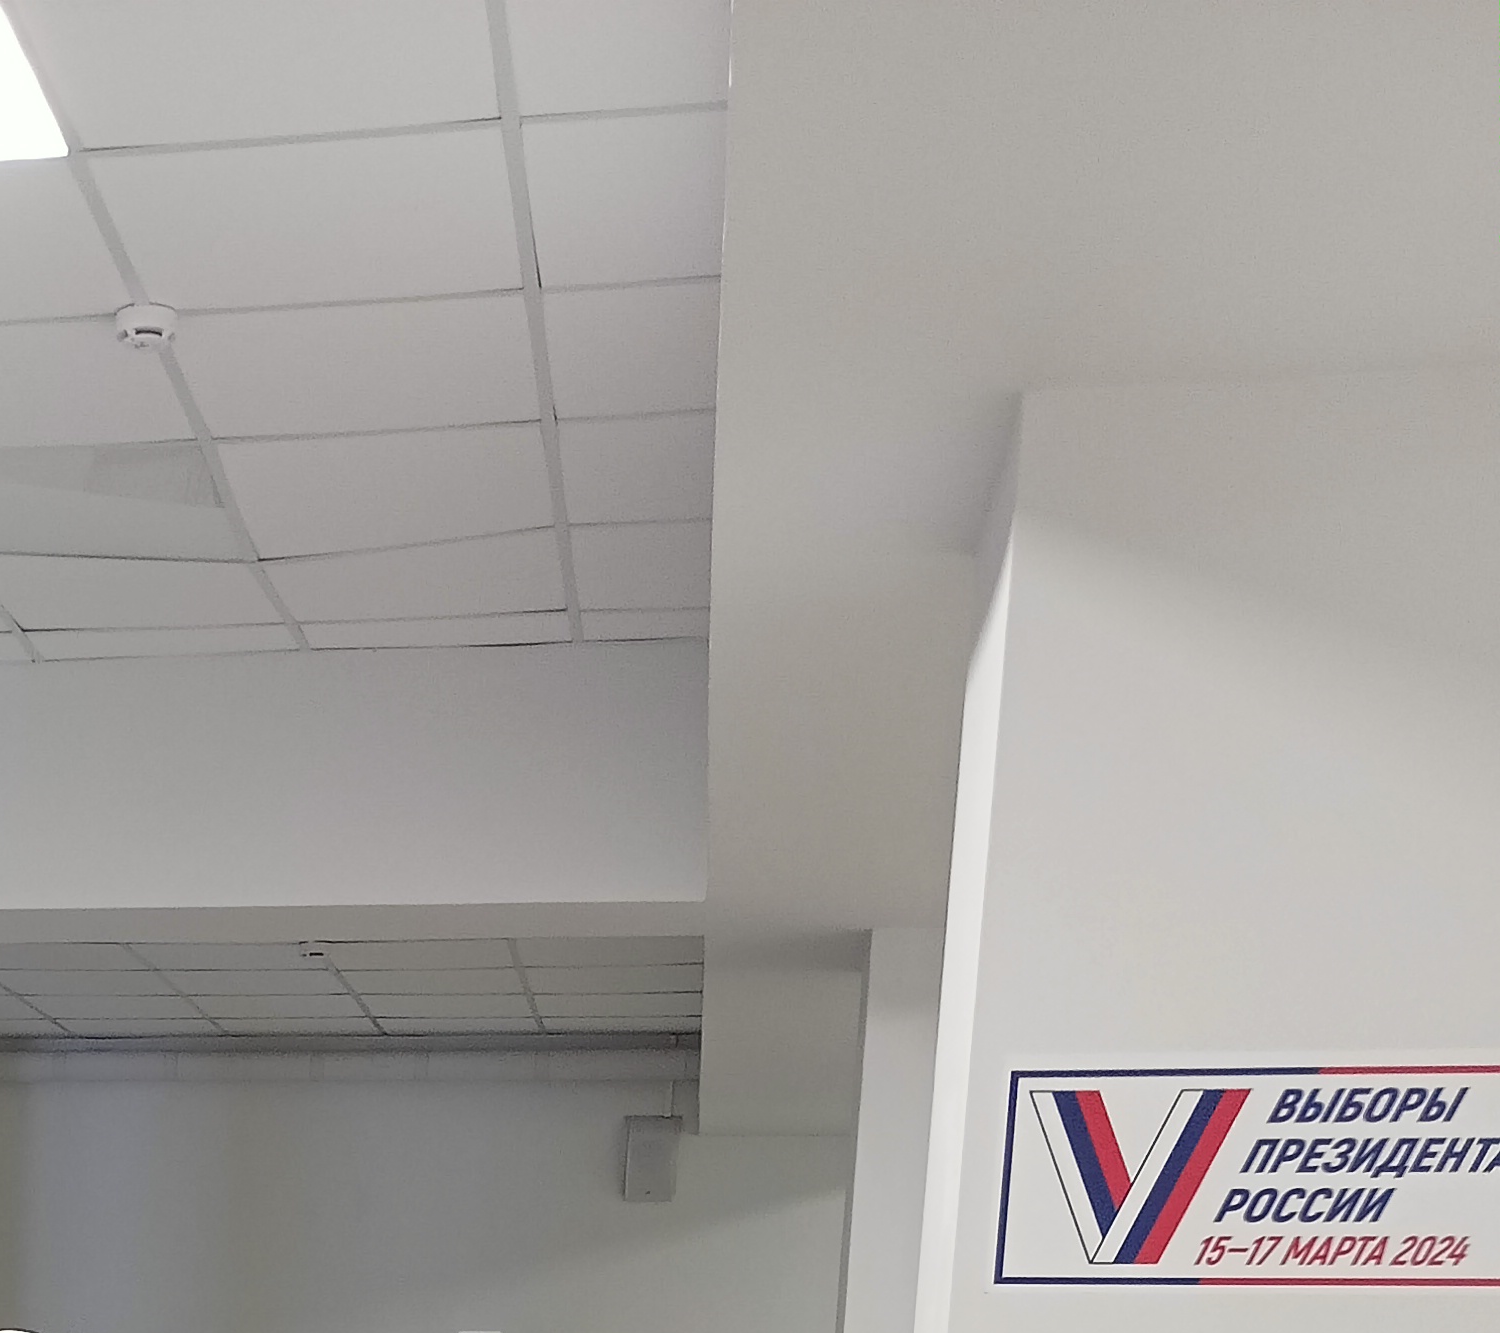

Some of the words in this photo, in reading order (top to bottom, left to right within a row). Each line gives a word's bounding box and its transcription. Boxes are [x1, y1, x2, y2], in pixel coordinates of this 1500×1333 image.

[1266, 1086, 1471, 1123] ВЫБОРЫ
[1213, 1187, 1398, 1223] РОССИИ
[1280, 1236, 1390, 1266] МАРТА
[1388, 1236, 1471, 1266] 2024
